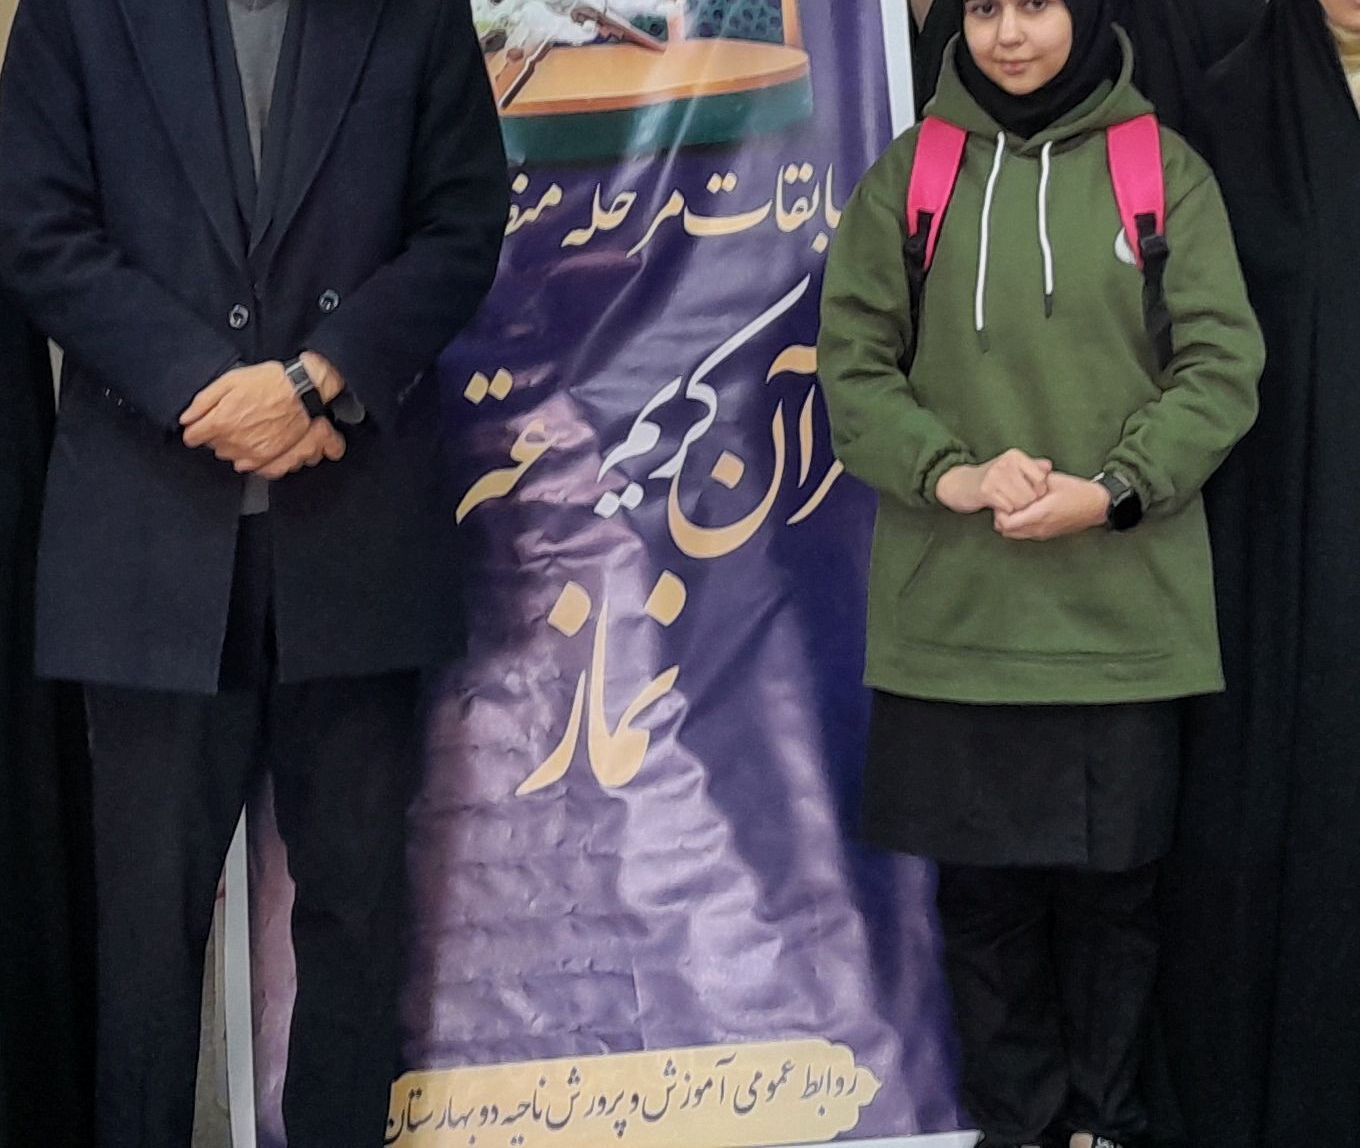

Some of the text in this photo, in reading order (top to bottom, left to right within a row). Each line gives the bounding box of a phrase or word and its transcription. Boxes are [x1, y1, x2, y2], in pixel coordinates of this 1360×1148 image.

[560, 181, 685, 259] مرحله
[683, 161, 842, 254] ابقات
[594, 271, 811, 519] کریم
[667, 344, 844, 559] رآن
[515, 570, 688, 796] نماز
[383, 1052, 858, 1147] روابط عمومی آموزش و پرورش ناحیه دو بهارستان
